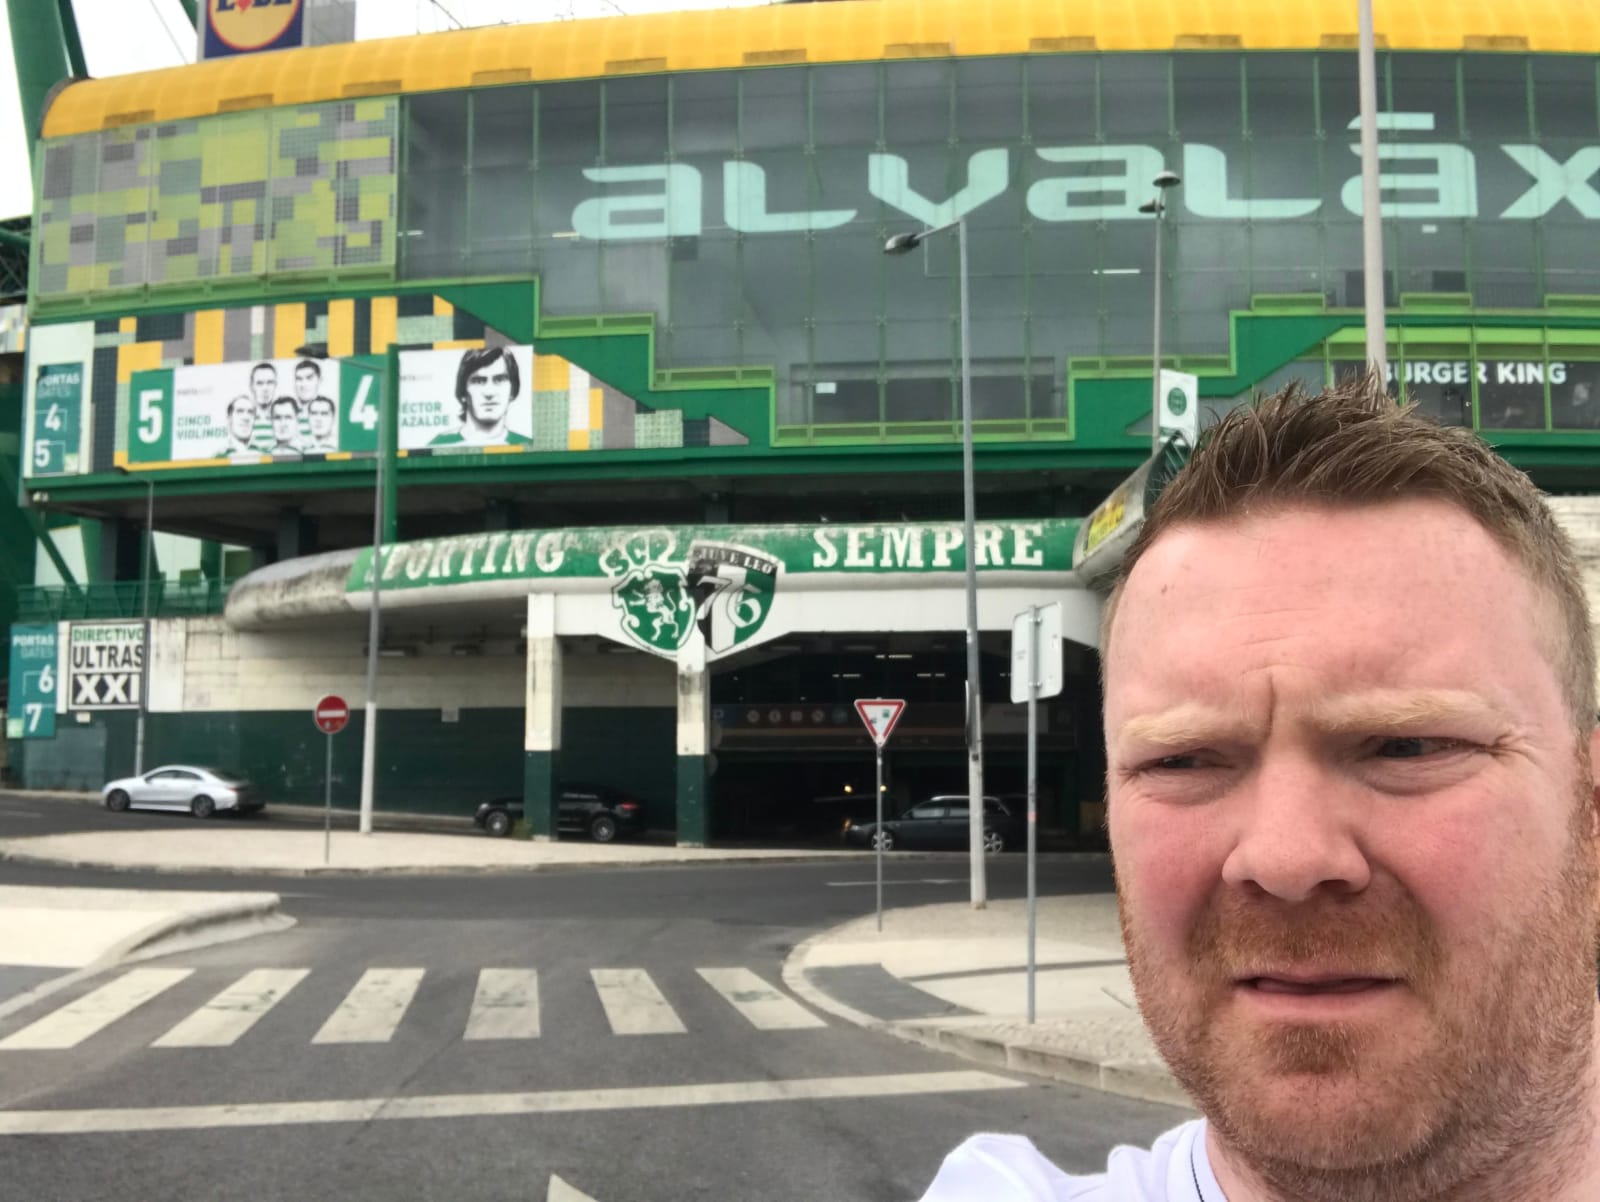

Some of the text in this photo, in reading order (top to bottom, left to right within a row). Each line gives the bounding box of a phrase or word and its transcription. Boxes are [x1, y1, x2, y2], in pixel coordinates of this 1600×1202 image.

[1497, 362, 1567, 384] KING
[348, 374, 378, 430] 4
[401, 400, 443, 414] ÉCTOR
[44, 403, 62, 431] 4
[137, 389, 164, 444] 5
[177, 415, 212, 427] CINCO
[401, 414, 449, 427] AZALDE
[177, 427, 229, 440] VIOLINOS
[34, 439, 51, 467] 5
[812, 524, 1044, 568] SEMPRE
[12, 634, 55, 646] PORTAS
[73, 627, 145, 643] DIRECTIVO
[73, 644, 143, 669] ULTRAS
[38, 664, 54, 693] 6
[75, 674, 141, 704] XXI
[26, 703, 43, 732] 7
